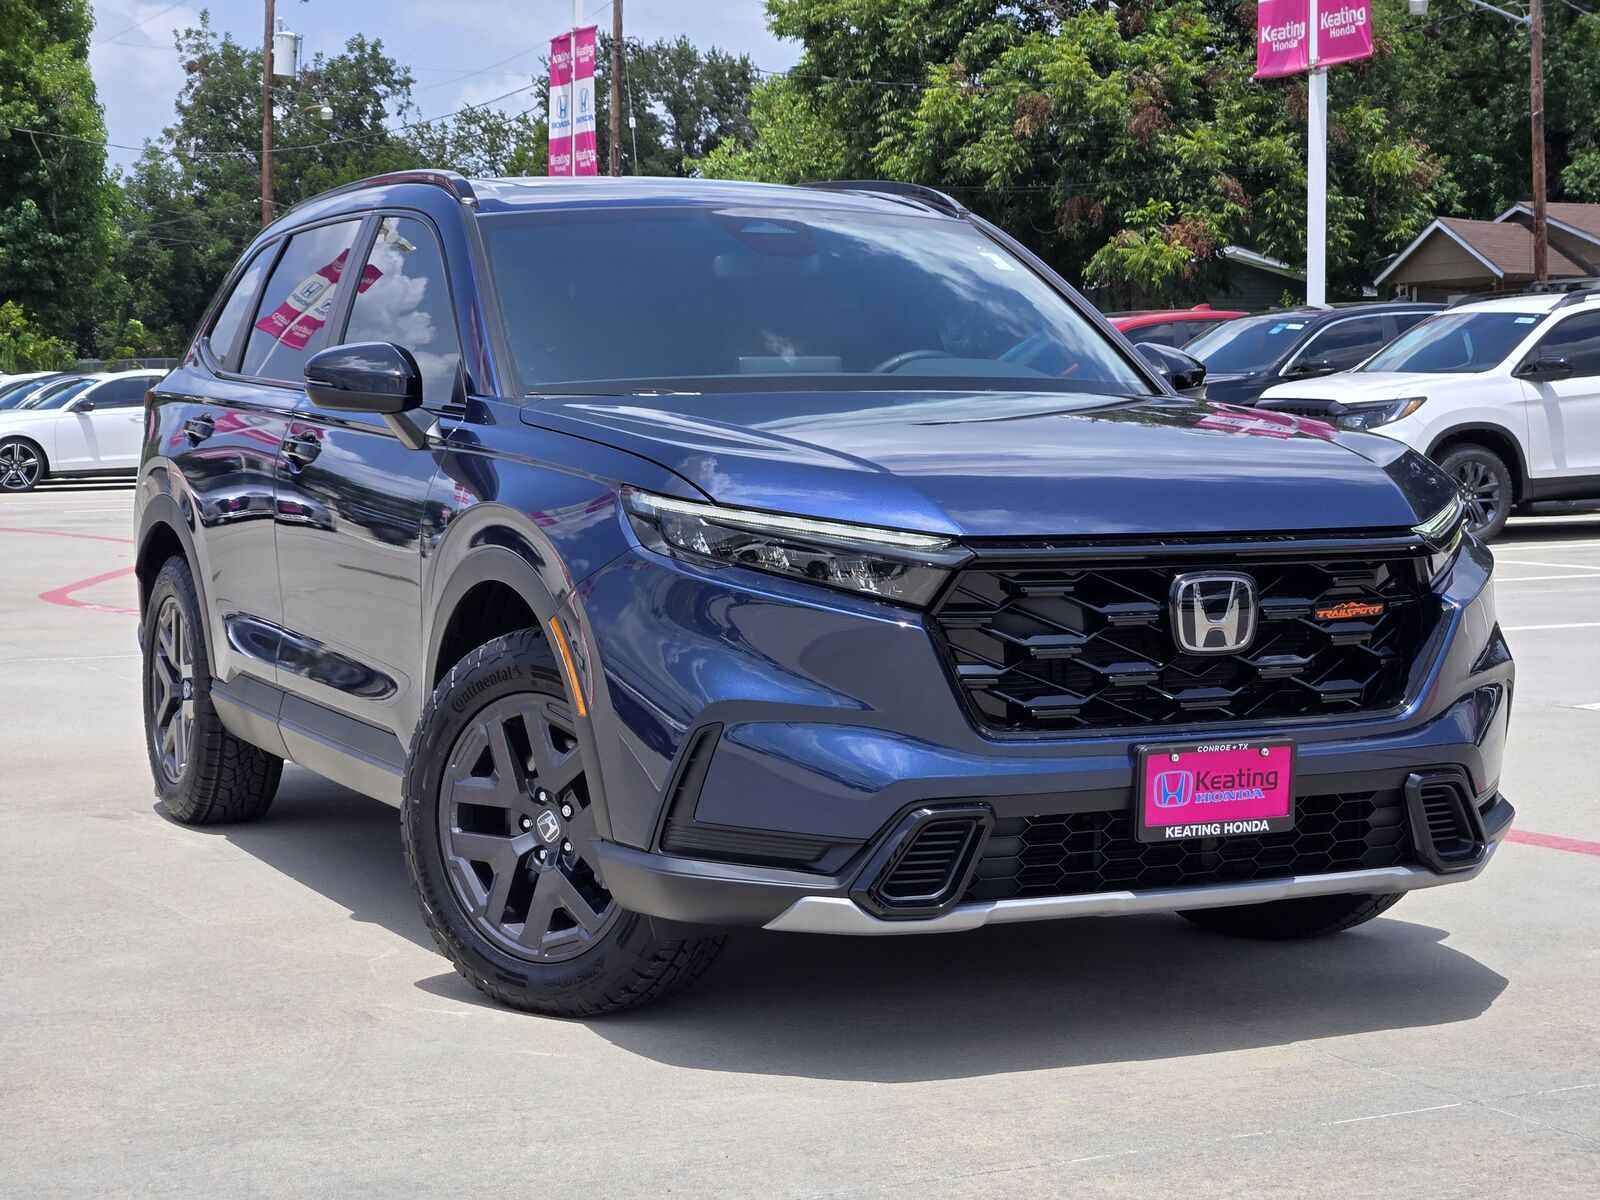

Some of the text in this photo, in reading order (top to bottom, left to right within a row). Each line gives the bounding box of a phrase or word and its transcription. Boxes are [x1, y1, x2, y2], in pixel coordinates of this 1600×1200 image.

[1320, 6, 1366, 30] Keating
[1261, 21, 1306, 43] Keating
[1330, 24, 1356, 39] Honda
[1272, 39, 1298, 52] Honda
[1317, 605, 1383, 619] TRAILSPORT
[452, 666, 513, 713] Continental
[1197, 743, 1249, 753] CONROE TX
[1195, 768, 1279, 791] Keating
[1195, 788, 1265, 804] HONDA
[1165, 820, 1270, 839] KEATING HONDA
